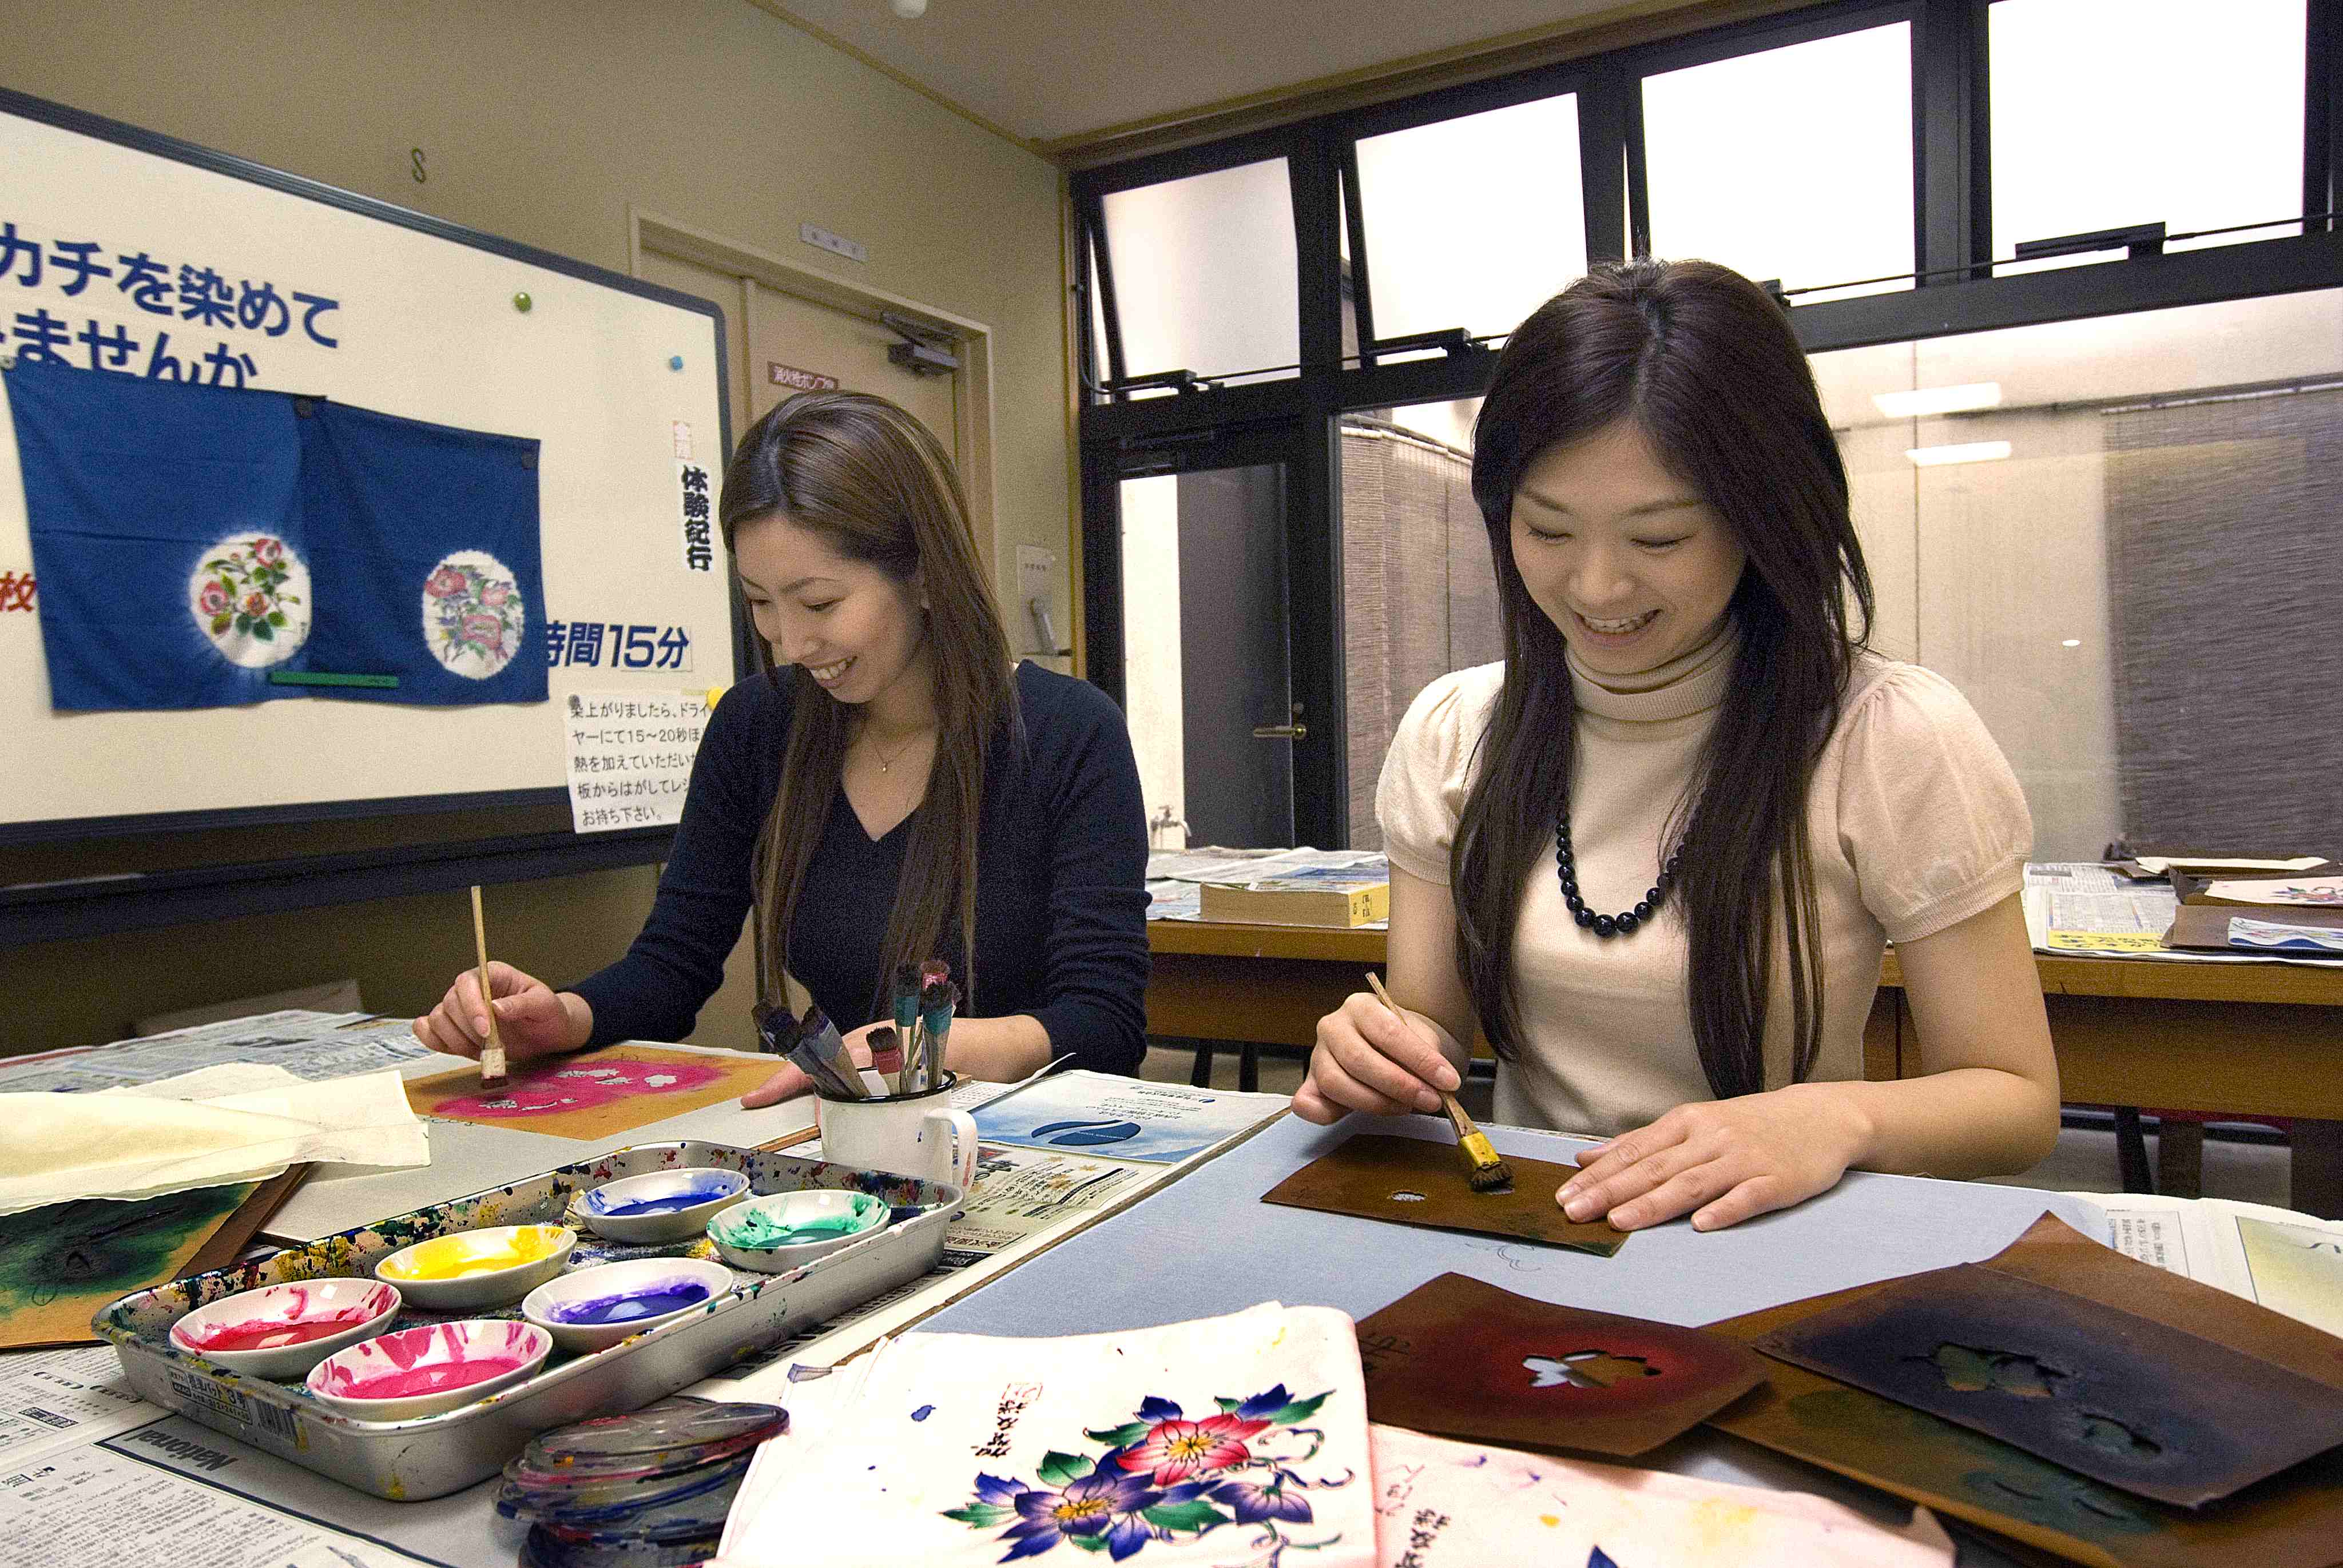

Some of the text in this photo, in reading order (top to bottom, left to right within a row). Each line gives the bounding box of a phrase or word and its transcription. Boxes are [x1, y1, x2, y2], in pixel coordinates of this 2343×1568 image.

[0, 222, 339, 348] カチを染めて
[0, 308, 257, 388] ませんか
[681, 465, 712, 571] 体験紀行
[572, 727, 705, 745] ヤーにて15～20秒ほ
[123, 1430, 238, 1471] National
